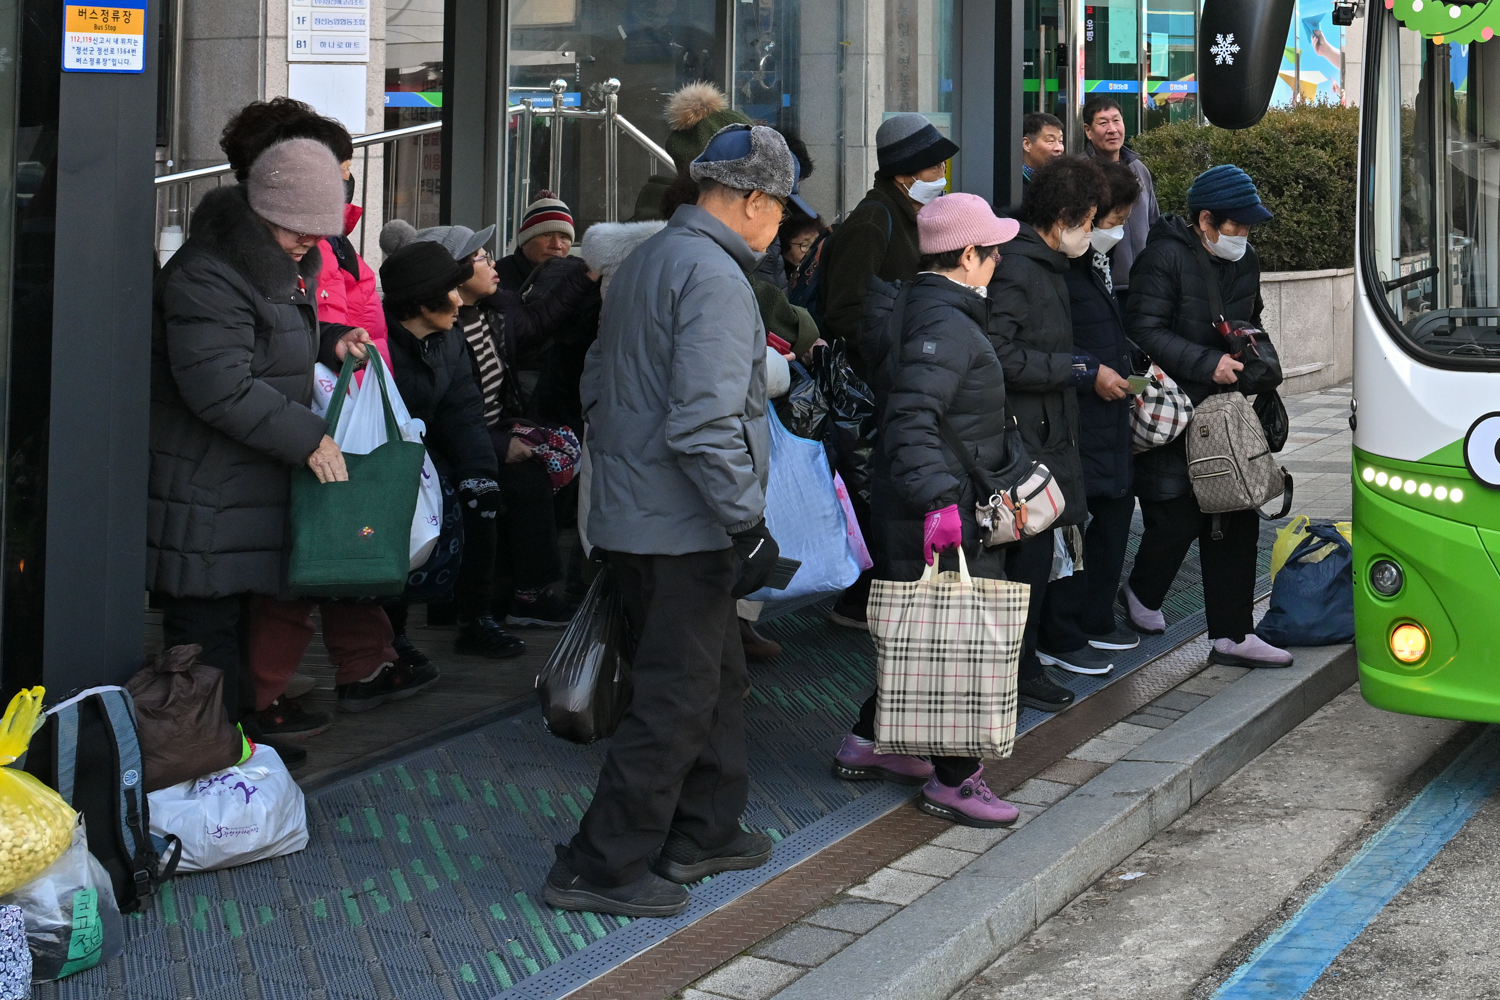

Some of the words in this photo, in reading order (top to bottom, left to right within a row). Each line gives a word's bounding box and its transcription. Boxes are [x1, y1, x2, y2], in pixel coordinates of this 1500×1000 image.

[78, 8, 132, 24] 버스정류장
[296, 16, 307, 25] 1F
[94, 23, 104, 31] Bus
[105, 24, 117, 32] Stop
[296, 40, 307, 49] B1
